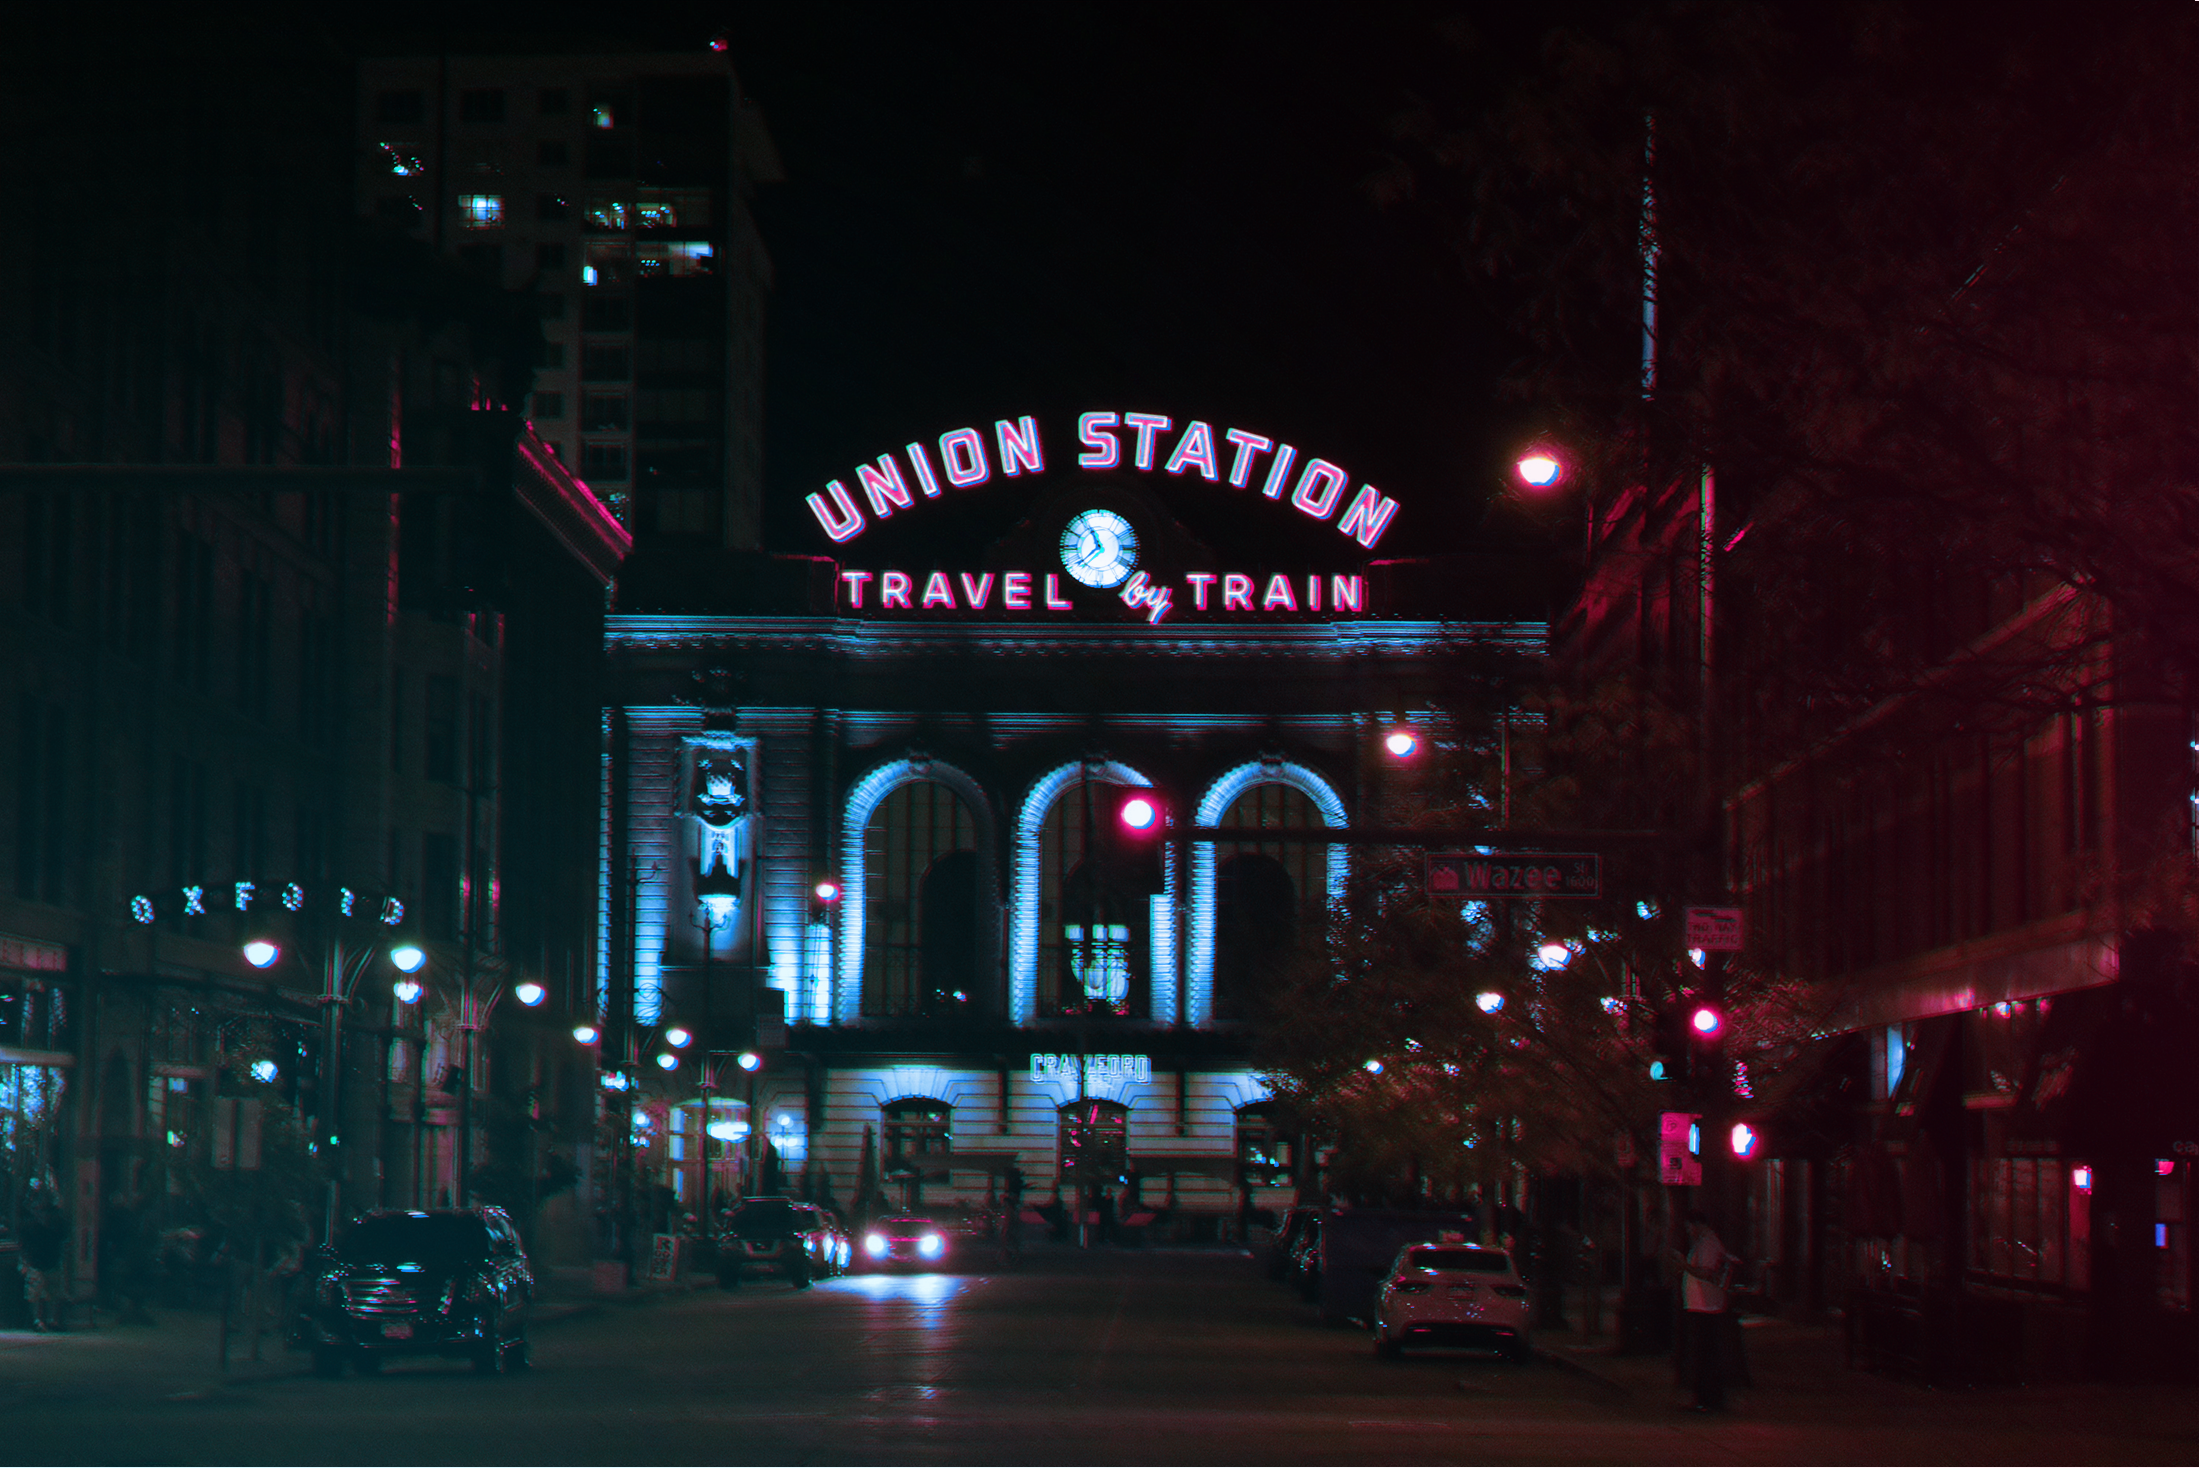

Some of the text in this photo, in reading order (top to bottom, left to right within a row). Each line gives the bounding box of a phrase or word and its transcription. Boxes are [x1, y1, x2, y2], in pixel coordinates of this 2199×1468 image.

[805, 414, 1044, 543] UNION
[1077, 410, 1399, 549] STATION
[841, 570, 1364, 625] TRAVEL by TRAIN
[1464, 861, 1562, 890] Wazee
[1565, 876, 1598, 890] 1600
[1688, 922, 1740, 934] TWO WAY
[1686, 934, 1742, 947] TRAFFIC
